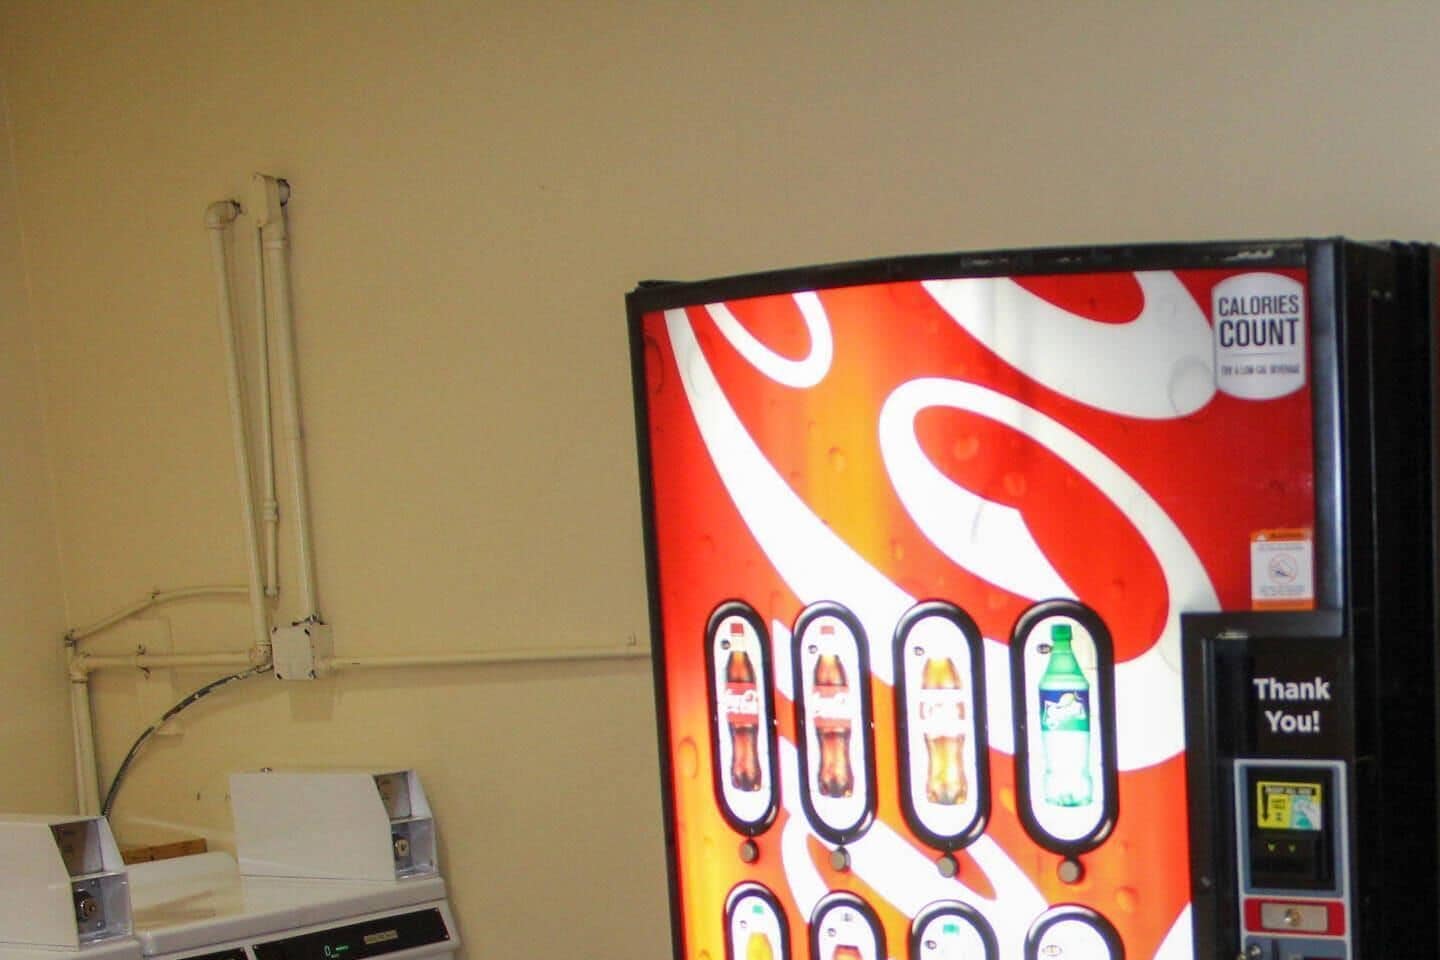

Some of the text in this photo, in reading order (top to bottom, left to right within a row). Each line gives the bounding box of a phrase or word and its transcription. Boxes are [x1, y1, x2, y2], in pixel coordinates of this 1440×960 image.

[1218, 294, 1299, 317] CALORIES
[1219, 317, 1299, 347] COUNT
[1253, 677, 1331, 700] Thank
[1265, 710, 1321, 733] You!
